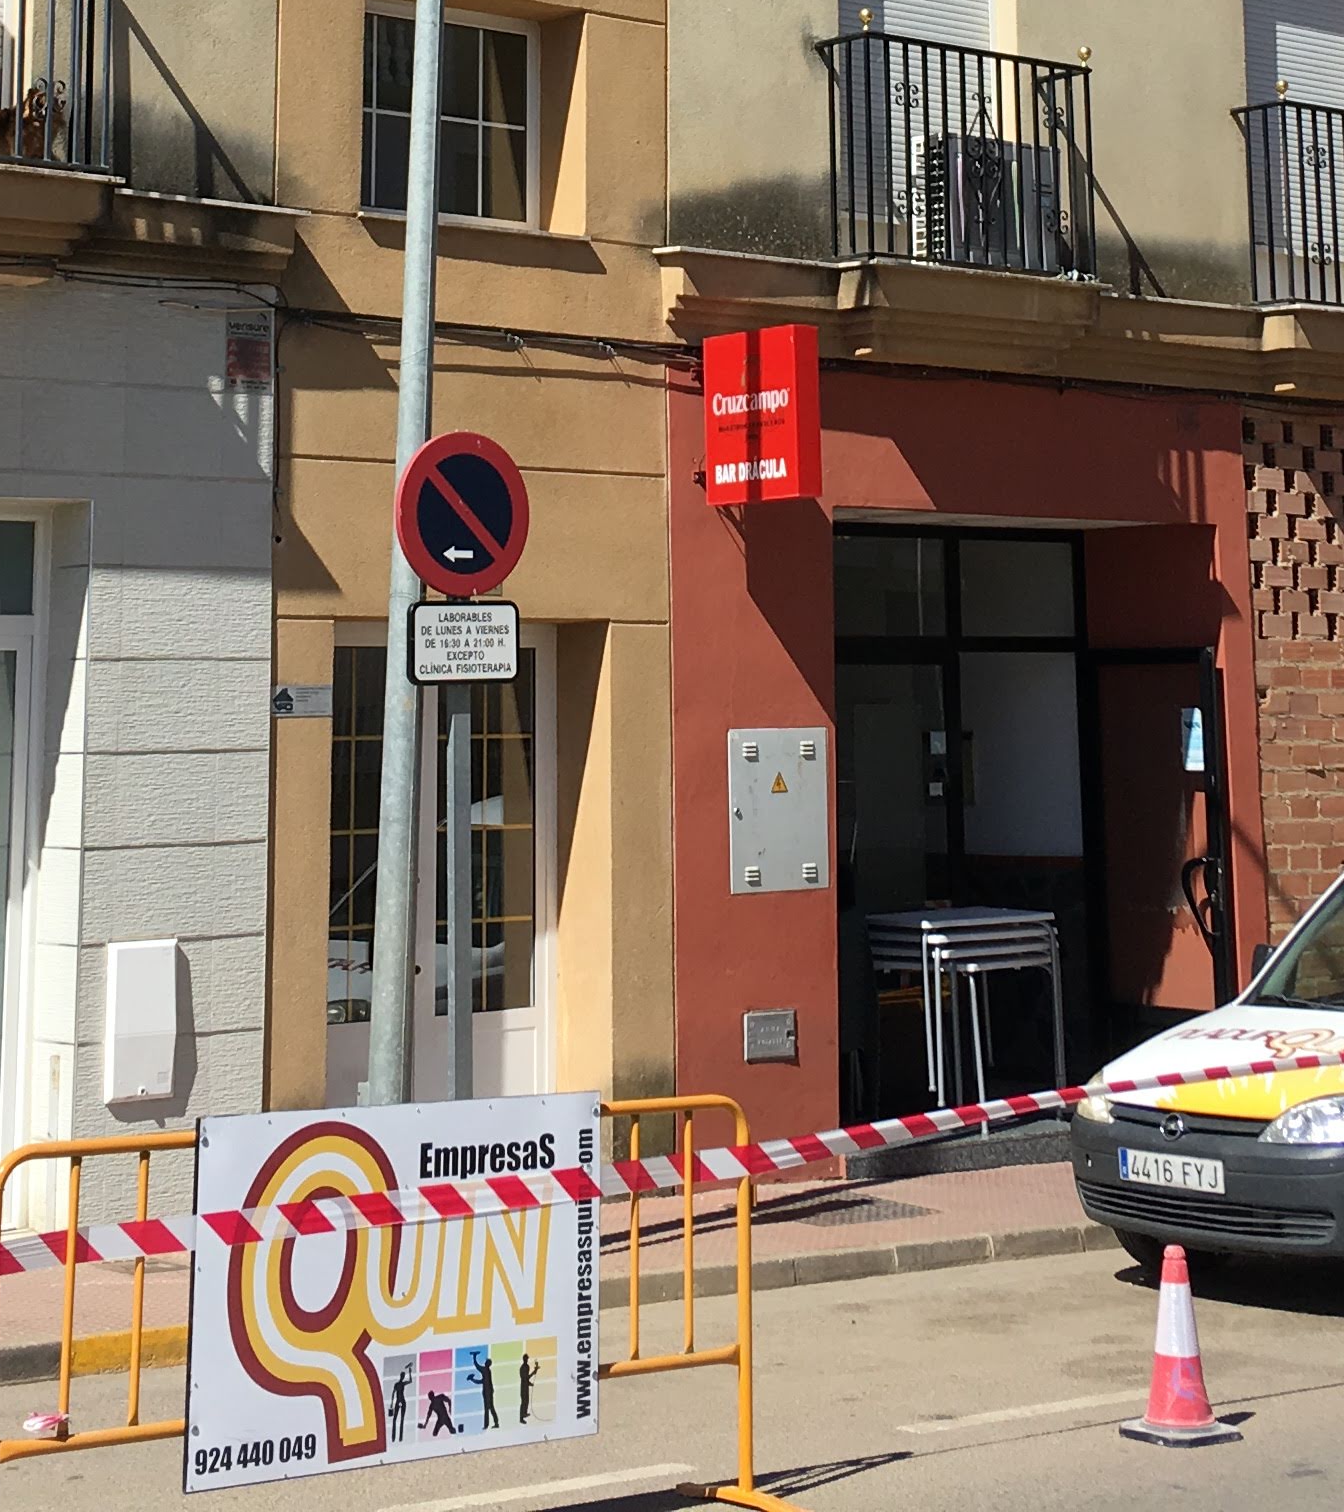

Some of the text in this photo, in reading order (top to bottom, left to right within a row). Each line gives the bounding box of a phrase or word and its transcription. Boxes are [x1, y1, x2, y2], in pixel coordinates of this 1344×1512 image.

[712, 388, 790, 417] Cruzcampo
[715, 455, 787, 486] BAR DRÁCULA
[421, 624, 510, 636] DE LUNES A VIERNES
[438, 612, 492, 623] LABORABLES
[424, 638, 436, 649] DE
[464, 638, 471, 648] A
[473, 637, 495, 648] 21:00
[497, 637, 506, 648] H.
[446, 650, 485, 661] EXCEPTO
[419, 661, 512, 675] CLÍNICA FISIOTERAPIA
[419, 1133, 555, 1180] EmpresaS
[1131, 1155, 1218, 1188] 4416 FYJ
[227, 1121, 554, 1464] QUIN
[194, 1433, 317, 1476] 924 440 049
